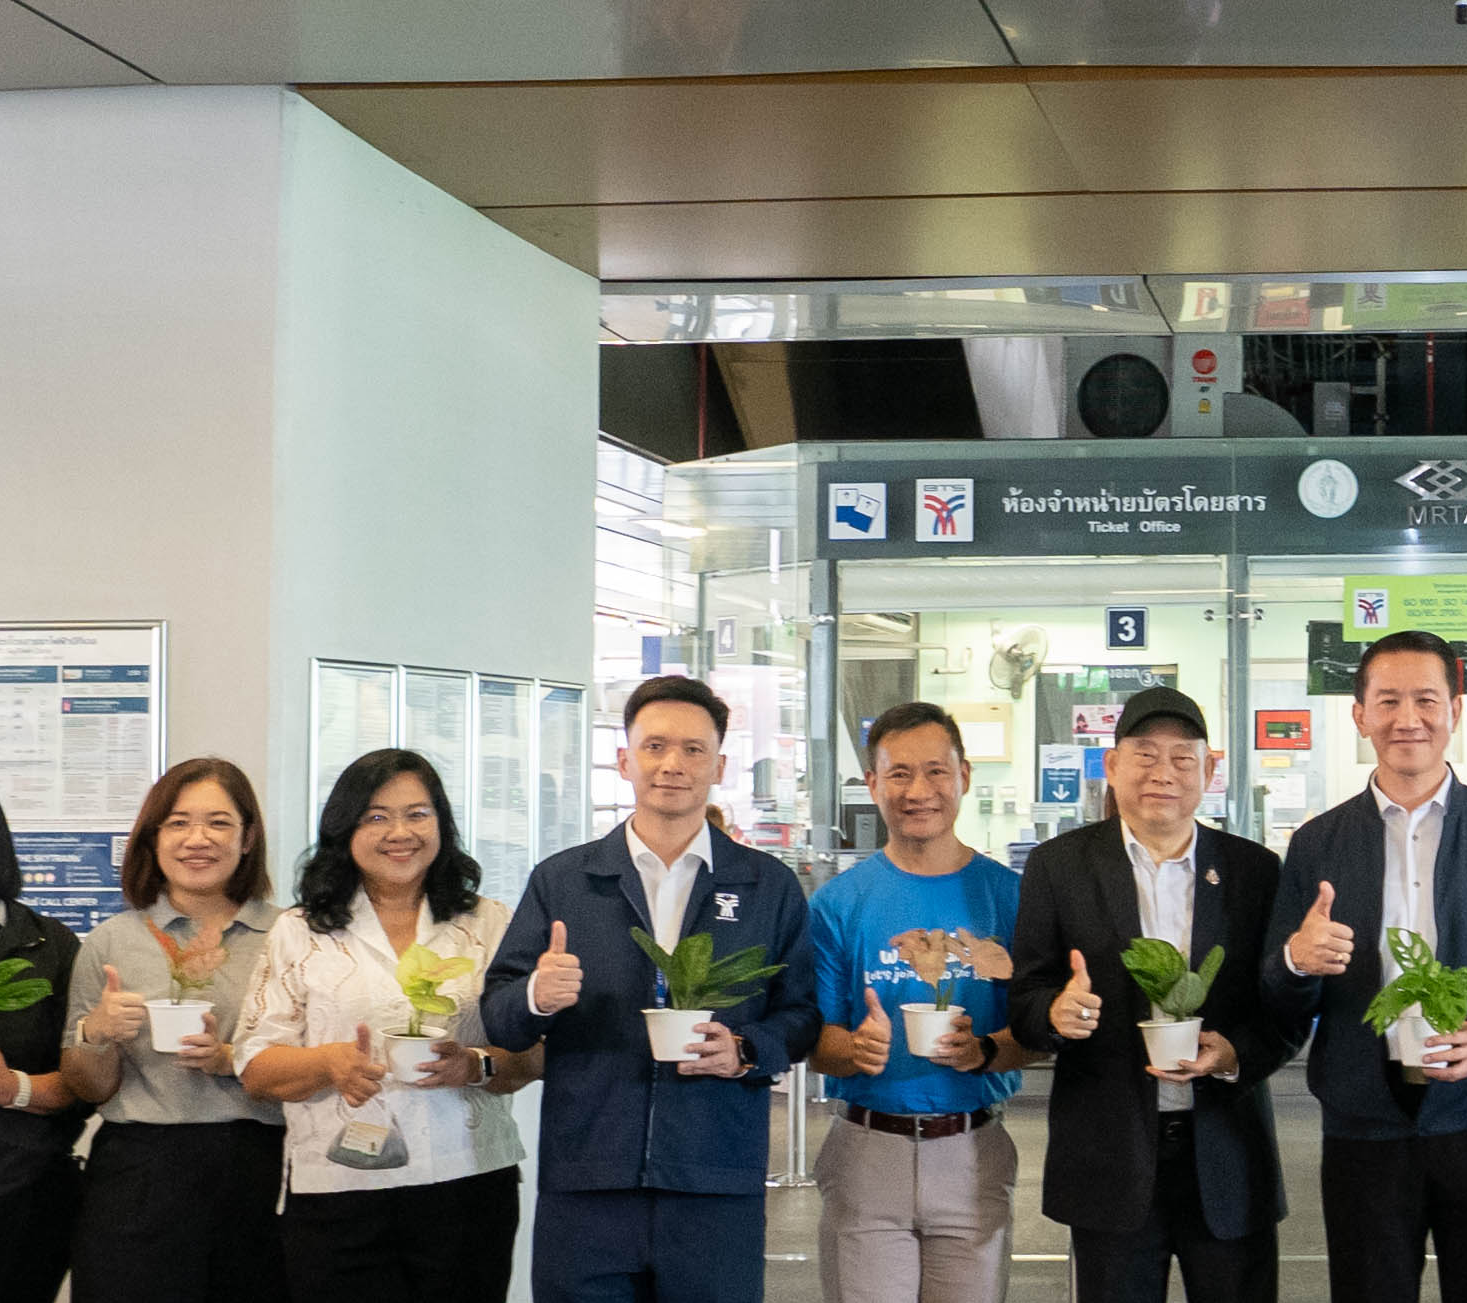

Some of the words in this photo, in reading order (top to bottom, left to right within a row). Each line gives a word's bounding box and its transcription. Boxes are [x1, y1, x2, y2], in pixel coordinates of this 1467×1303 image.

[1002, 486, 1268, 515] ห้องจำหน่ายบัตรโดยสาร
[1088, 521, 1130, 534] Ticket
[1140, 521, 1182, 534] Office
[1117, 615, 1137, 642] 3
